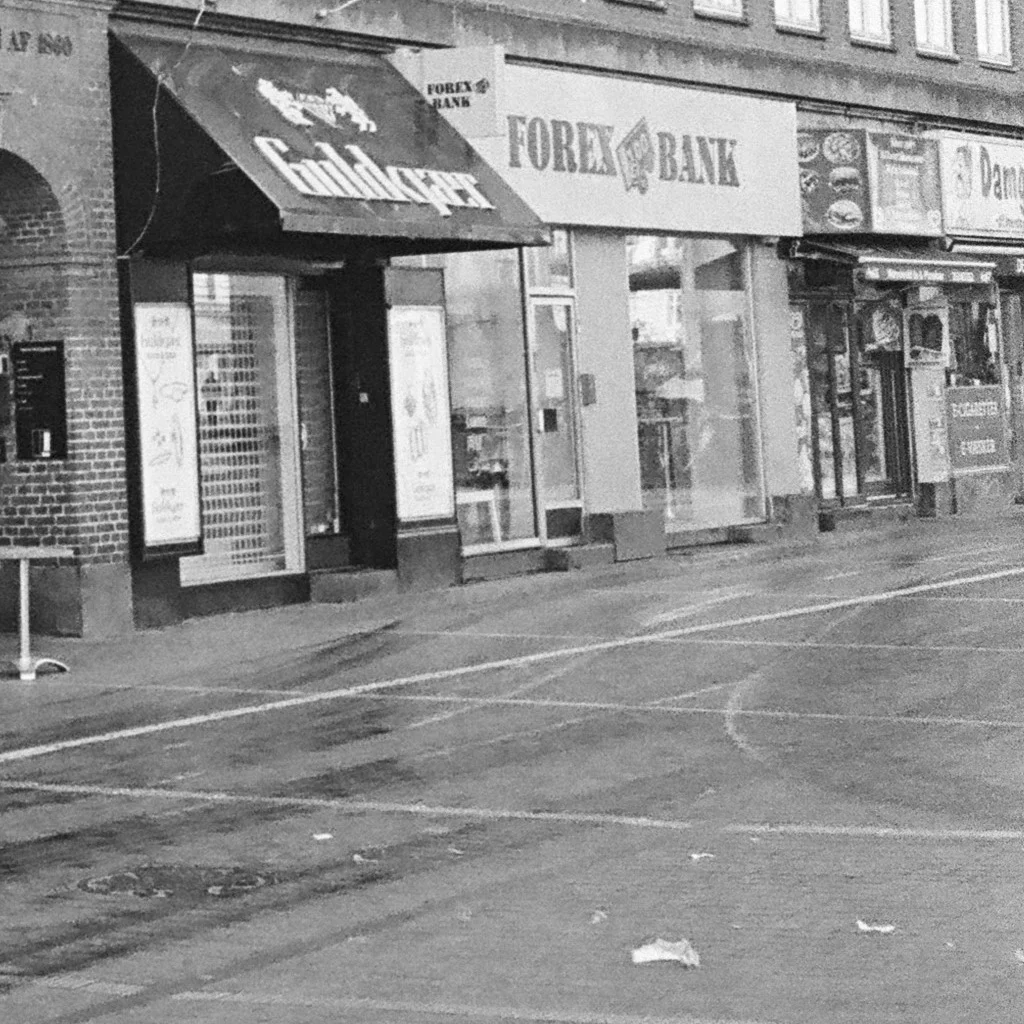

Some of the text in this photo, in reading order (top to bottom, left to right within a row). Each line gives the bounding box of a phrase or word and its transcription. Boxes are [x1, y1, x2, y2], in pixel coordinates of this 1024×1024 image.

[7, 30, 32, 53] AF
[426, 80, 473, 95] FOREX
[431, 96, 471, 110] BANK
[506, 114, 741, 187] FOREX BANK
